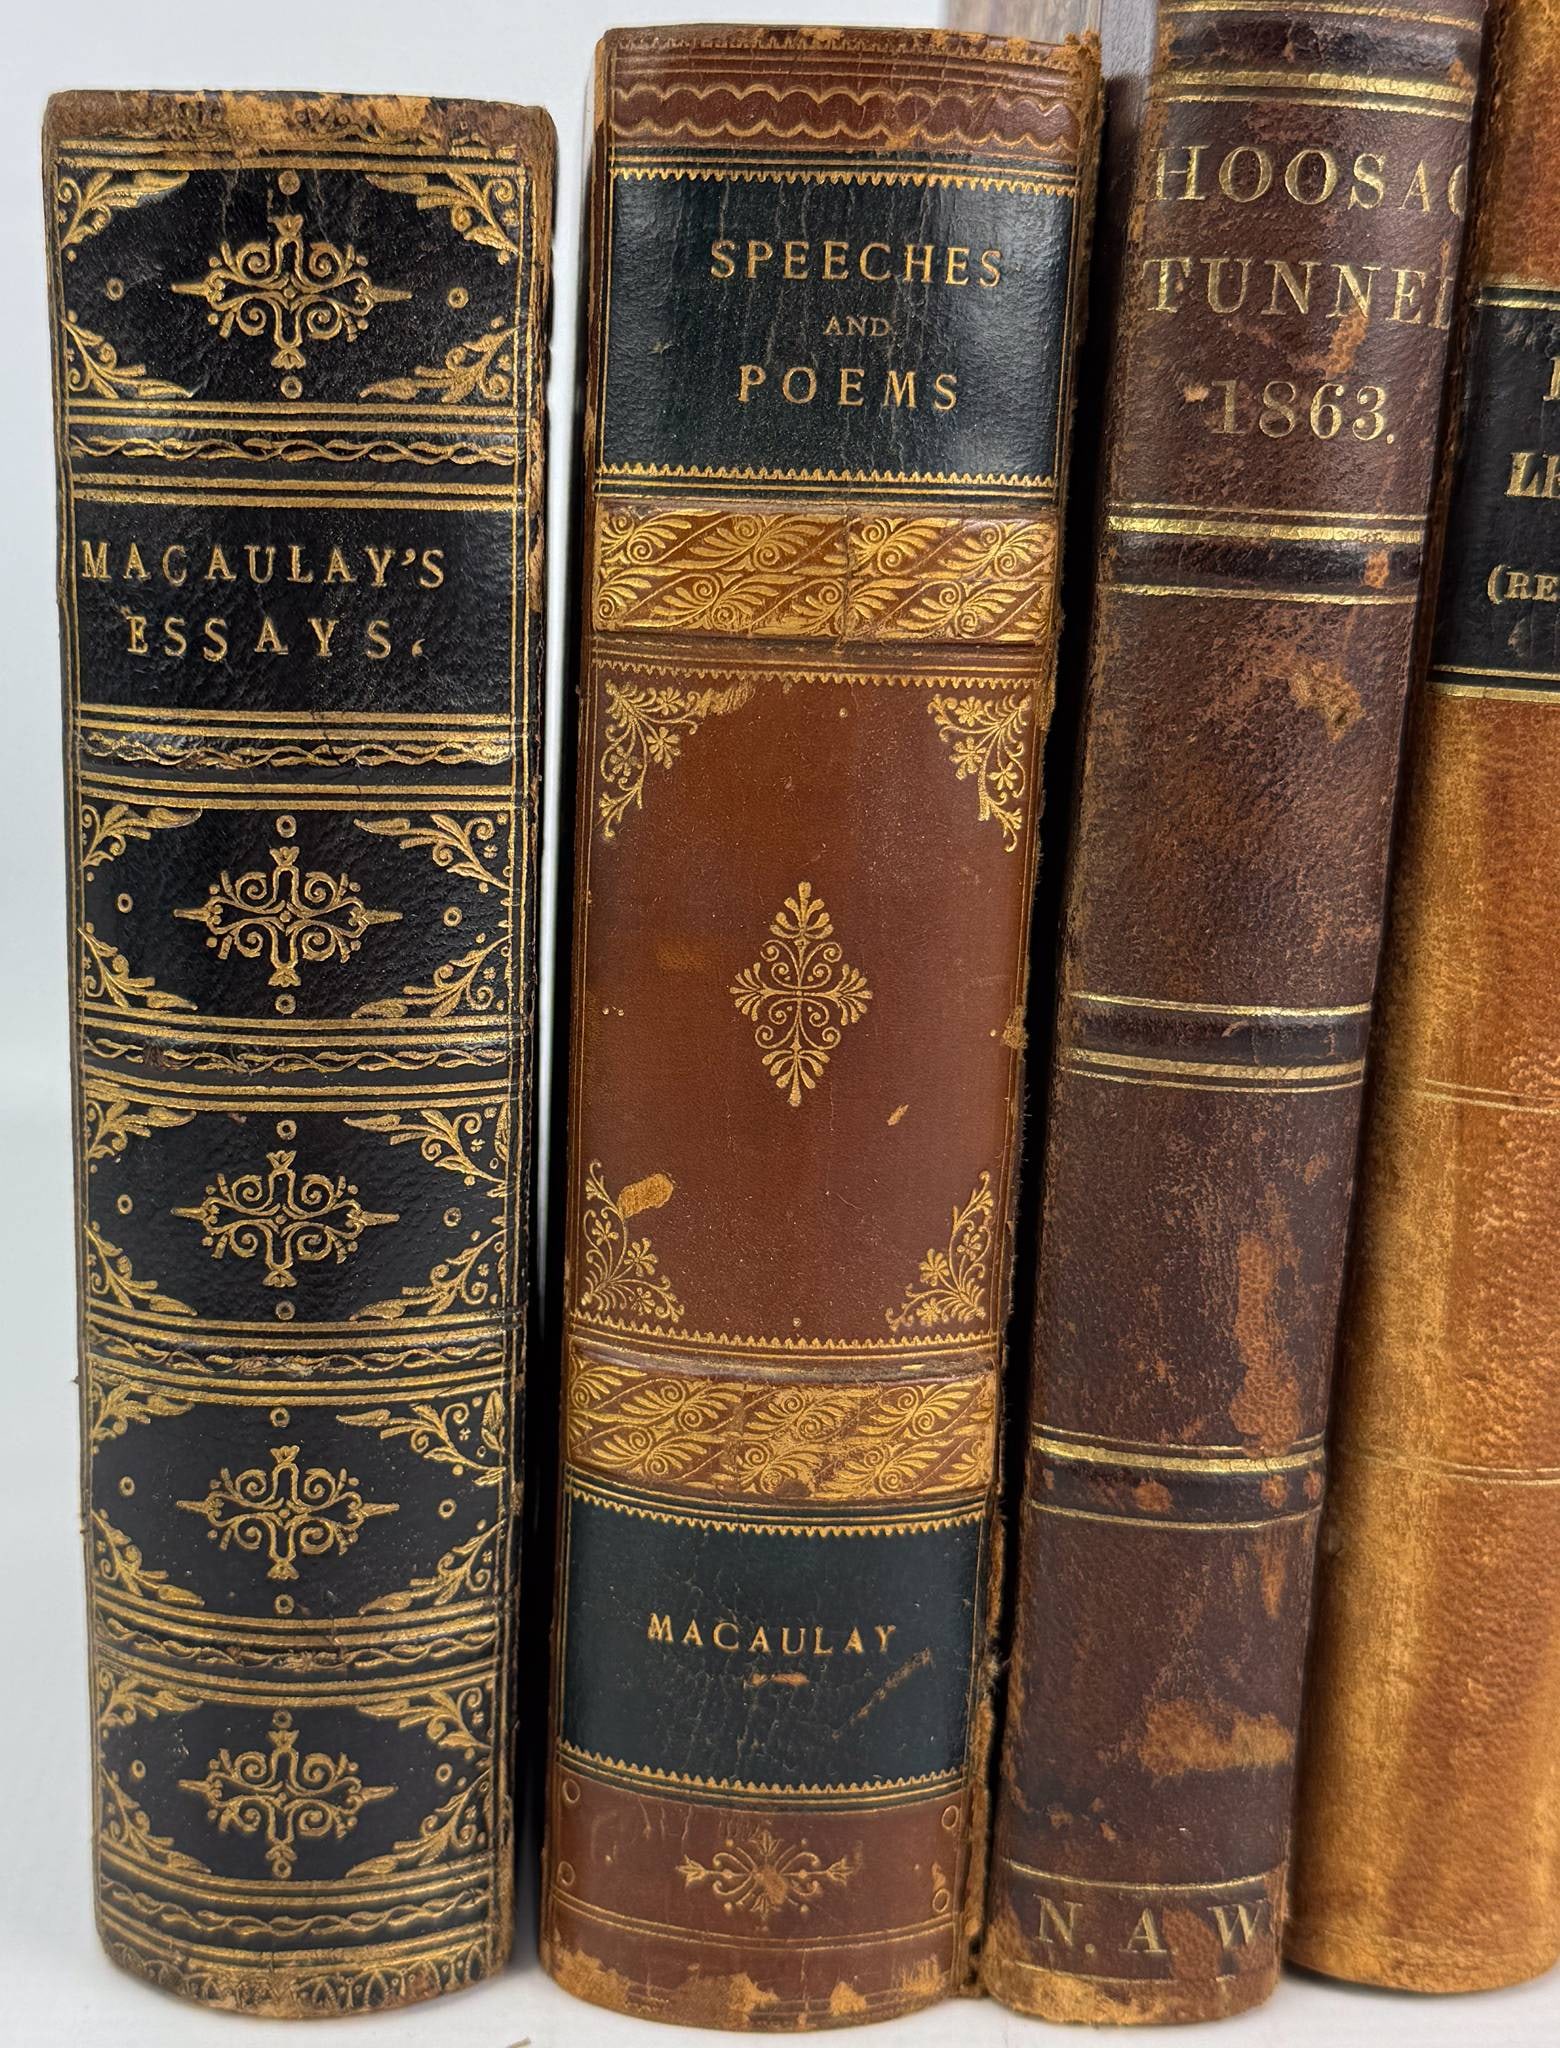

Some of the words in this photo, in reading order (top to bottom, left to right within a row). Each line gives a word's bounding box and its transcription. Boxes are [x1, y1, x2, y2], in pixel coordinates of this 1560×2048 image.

[710, 239, 1002, 288] SPEECHES
[823, 315, 891, 337] AND
[737, 364, 958, 413] POEMS
[1210, 378, 1395, 444] 1863.
[80, 540, 445, 589] MACAULAY'S
[647, 1611, 897, 1656] MACAULAY
[1033, 1893, 1096, 1955] N.
